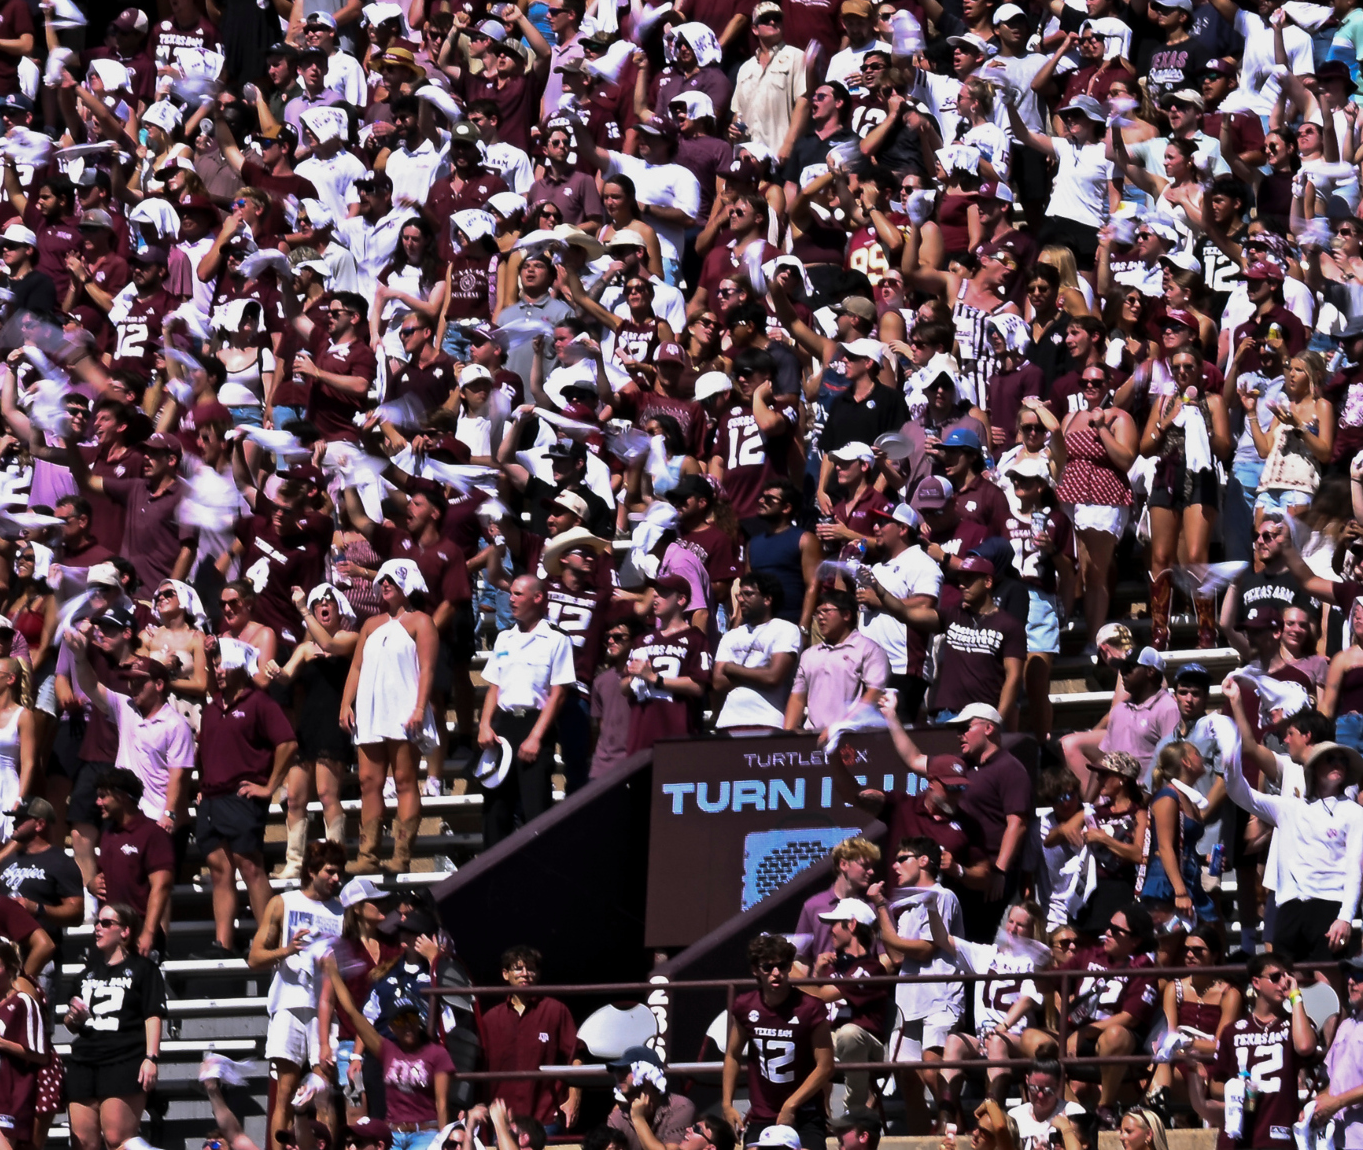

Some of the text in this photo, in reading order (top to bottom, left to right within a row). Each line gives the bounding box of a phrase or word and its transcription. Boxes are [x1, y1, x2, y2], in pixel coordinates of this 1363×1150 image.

[1150, 50, 1188, 69] TEXAS
[851, 107, 887, 137] 12
[1204, 256, 1240, 289] 12
[114, 324, 148, 359] 12
[727, 428, 765, 469] 12
[1243, 581, 1295, 605] TEXAS A&M
[662, 778, 805, 814] TURN
[0, 864, 45, 887] Aggies
[83, 988, 125, 1031] 12
[754, 1027, 793, 1039] TEXAS A&M
[1233, 1033, 1264, 1047] TEXAS
[753, 1039, 795, 1084] 12
[1235, 1044, 1283, 1093] 12
